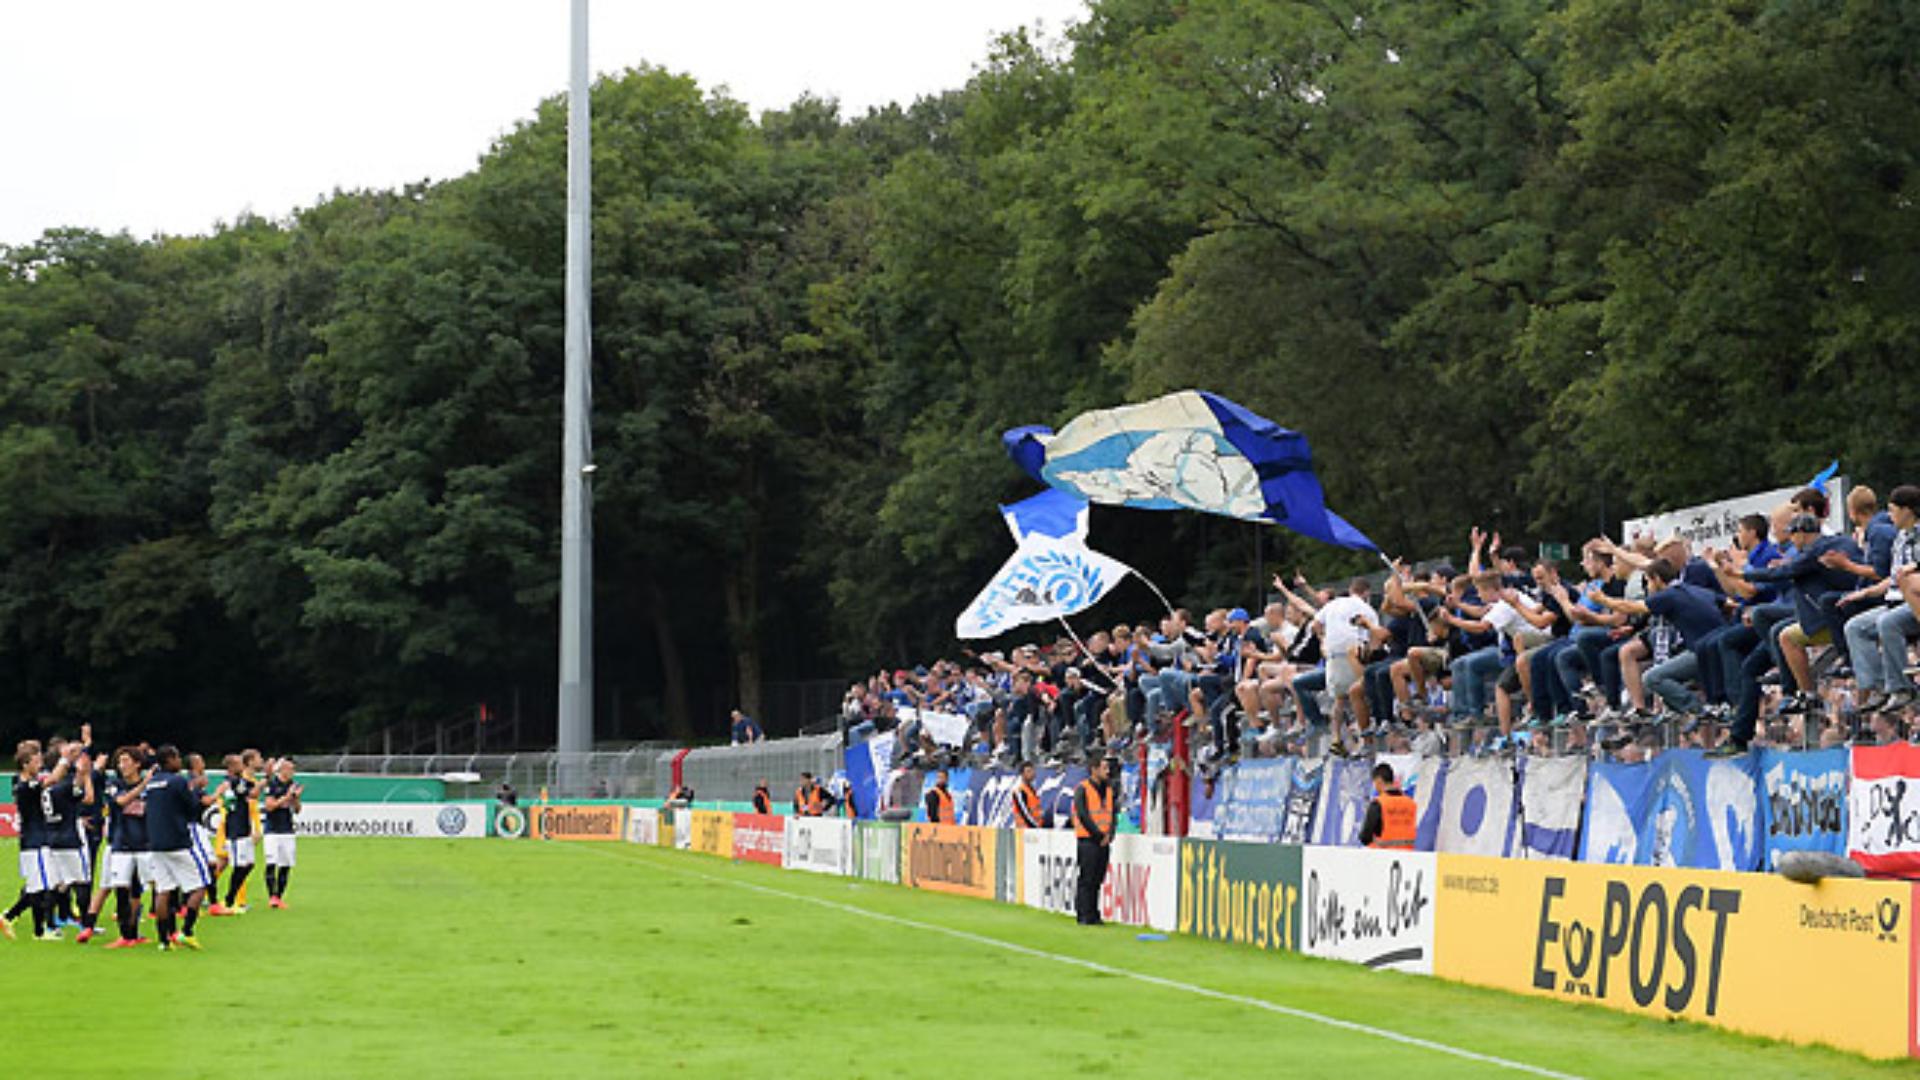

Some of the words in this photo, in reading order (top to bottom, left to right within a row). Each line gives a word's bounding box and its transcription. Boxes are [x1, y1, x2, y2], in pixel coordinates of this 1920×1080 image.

[1102, 862, 1152, 926] BANK
[1179, 842, 1297, 951] Bitburger
[1308, 869, 1347, 948] Bitte
[1352, 896, 1382, 940] ein
[1387, 860, 1428, 936] Bit
[1800, 903, 1848, 932] Deutsche
[1849, 907, 1874, 934] Post
